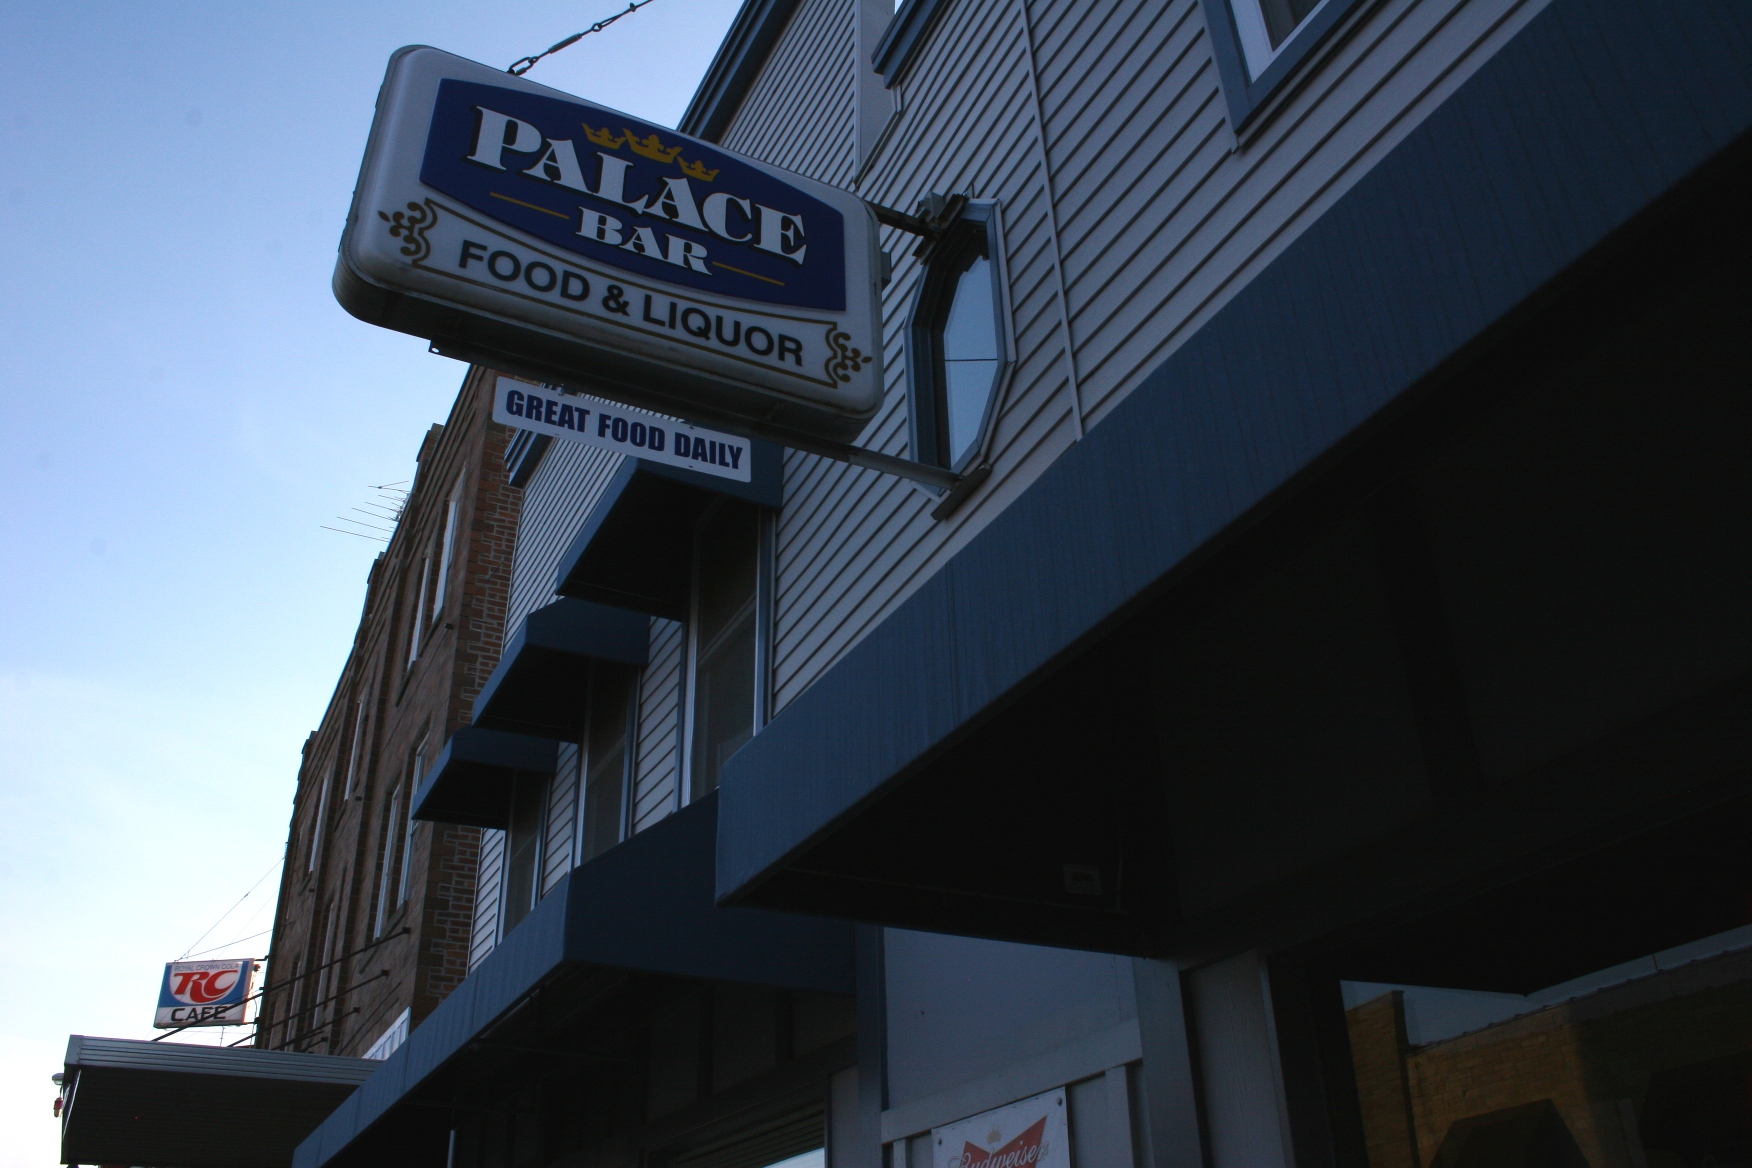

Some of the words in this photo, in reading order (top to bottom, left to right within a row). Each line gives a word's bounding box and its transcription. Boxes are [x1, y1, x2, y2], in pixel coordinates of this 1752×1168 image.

[465, 105, 807, 266] PALACE
[575, 206, 713, 276] BAR
[458, 239, 591, 302] FOOD
[601, 283, 631, 316] &
[643, 293, 804, 366] LIQUOR
[505, 390, 590, 433] GREAT
[598, 412, 665, 452] FOOD
[674, 431, 743, 470] DAILY
[173, 969, 238, 1003] RC
[196, 963, 220, 971] CROWN
[170, 1005, 227, 1022] CAFE
